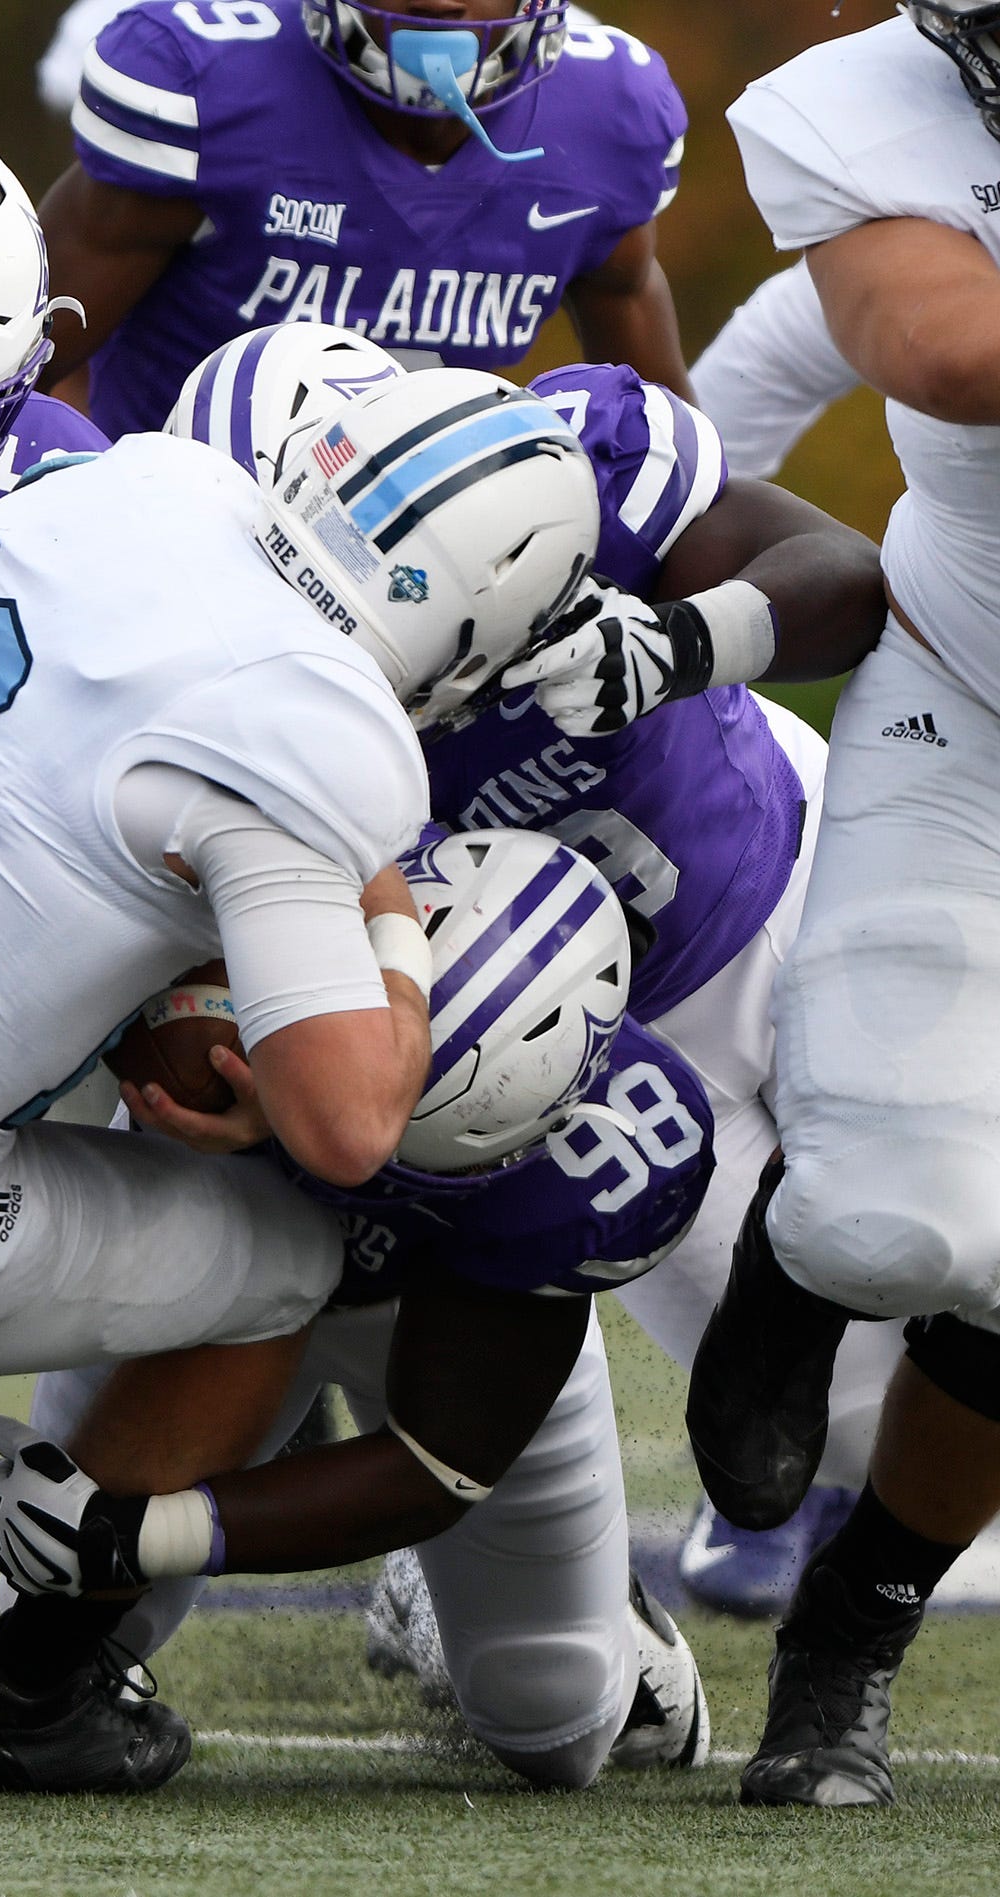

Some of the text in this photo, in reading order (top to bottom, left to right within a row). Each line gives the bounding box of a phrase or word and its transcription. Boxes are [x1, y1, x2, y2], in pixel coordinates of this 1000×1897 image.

[264, 193, 347, 246] SOCON
[238, 255, 558, 348] PALADINS
[264, 522, 299, 568] THE
[296, 566, 358, 636] CORPS
[881, 726, 949, 748] adidas
[546, 1060, 705, 1212] 98
[0, 1183, 23, 1243] adidas
